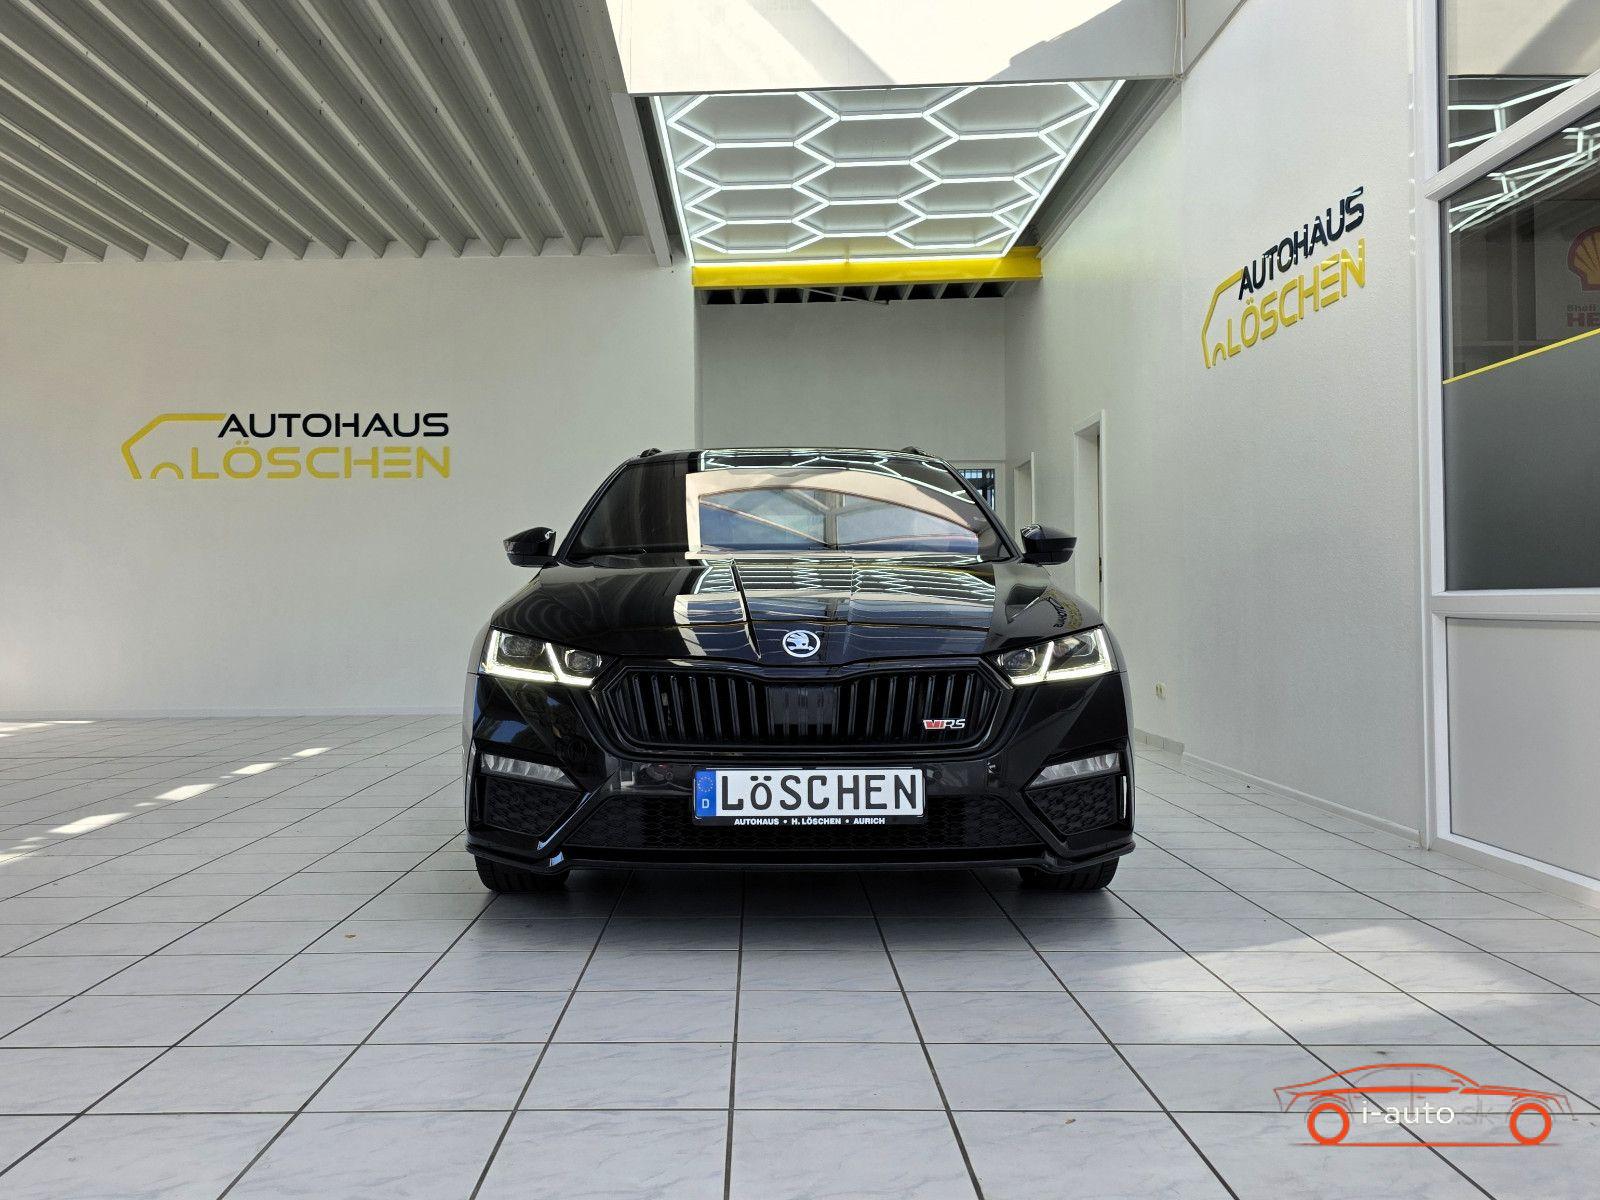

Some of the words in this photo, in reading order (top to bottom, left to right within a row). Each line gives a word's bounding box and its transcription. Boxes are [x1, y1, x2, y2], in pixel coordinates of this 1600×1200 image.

[1238, 186, 1365, 301] AUTOHAUS
[1227, 237, 1366, 358] LÖSCHEN
[217, 412, 449, 438] AUTOHAUS
[190, 440, 450, 480] LÖSCHEN
[701, 798, 710, 809] D
[734, 818, 780, 826] AUTOHAUS
[801, 816, 841, 825] LÖSCHEN
[853, 817, 886, 825] AURICH
